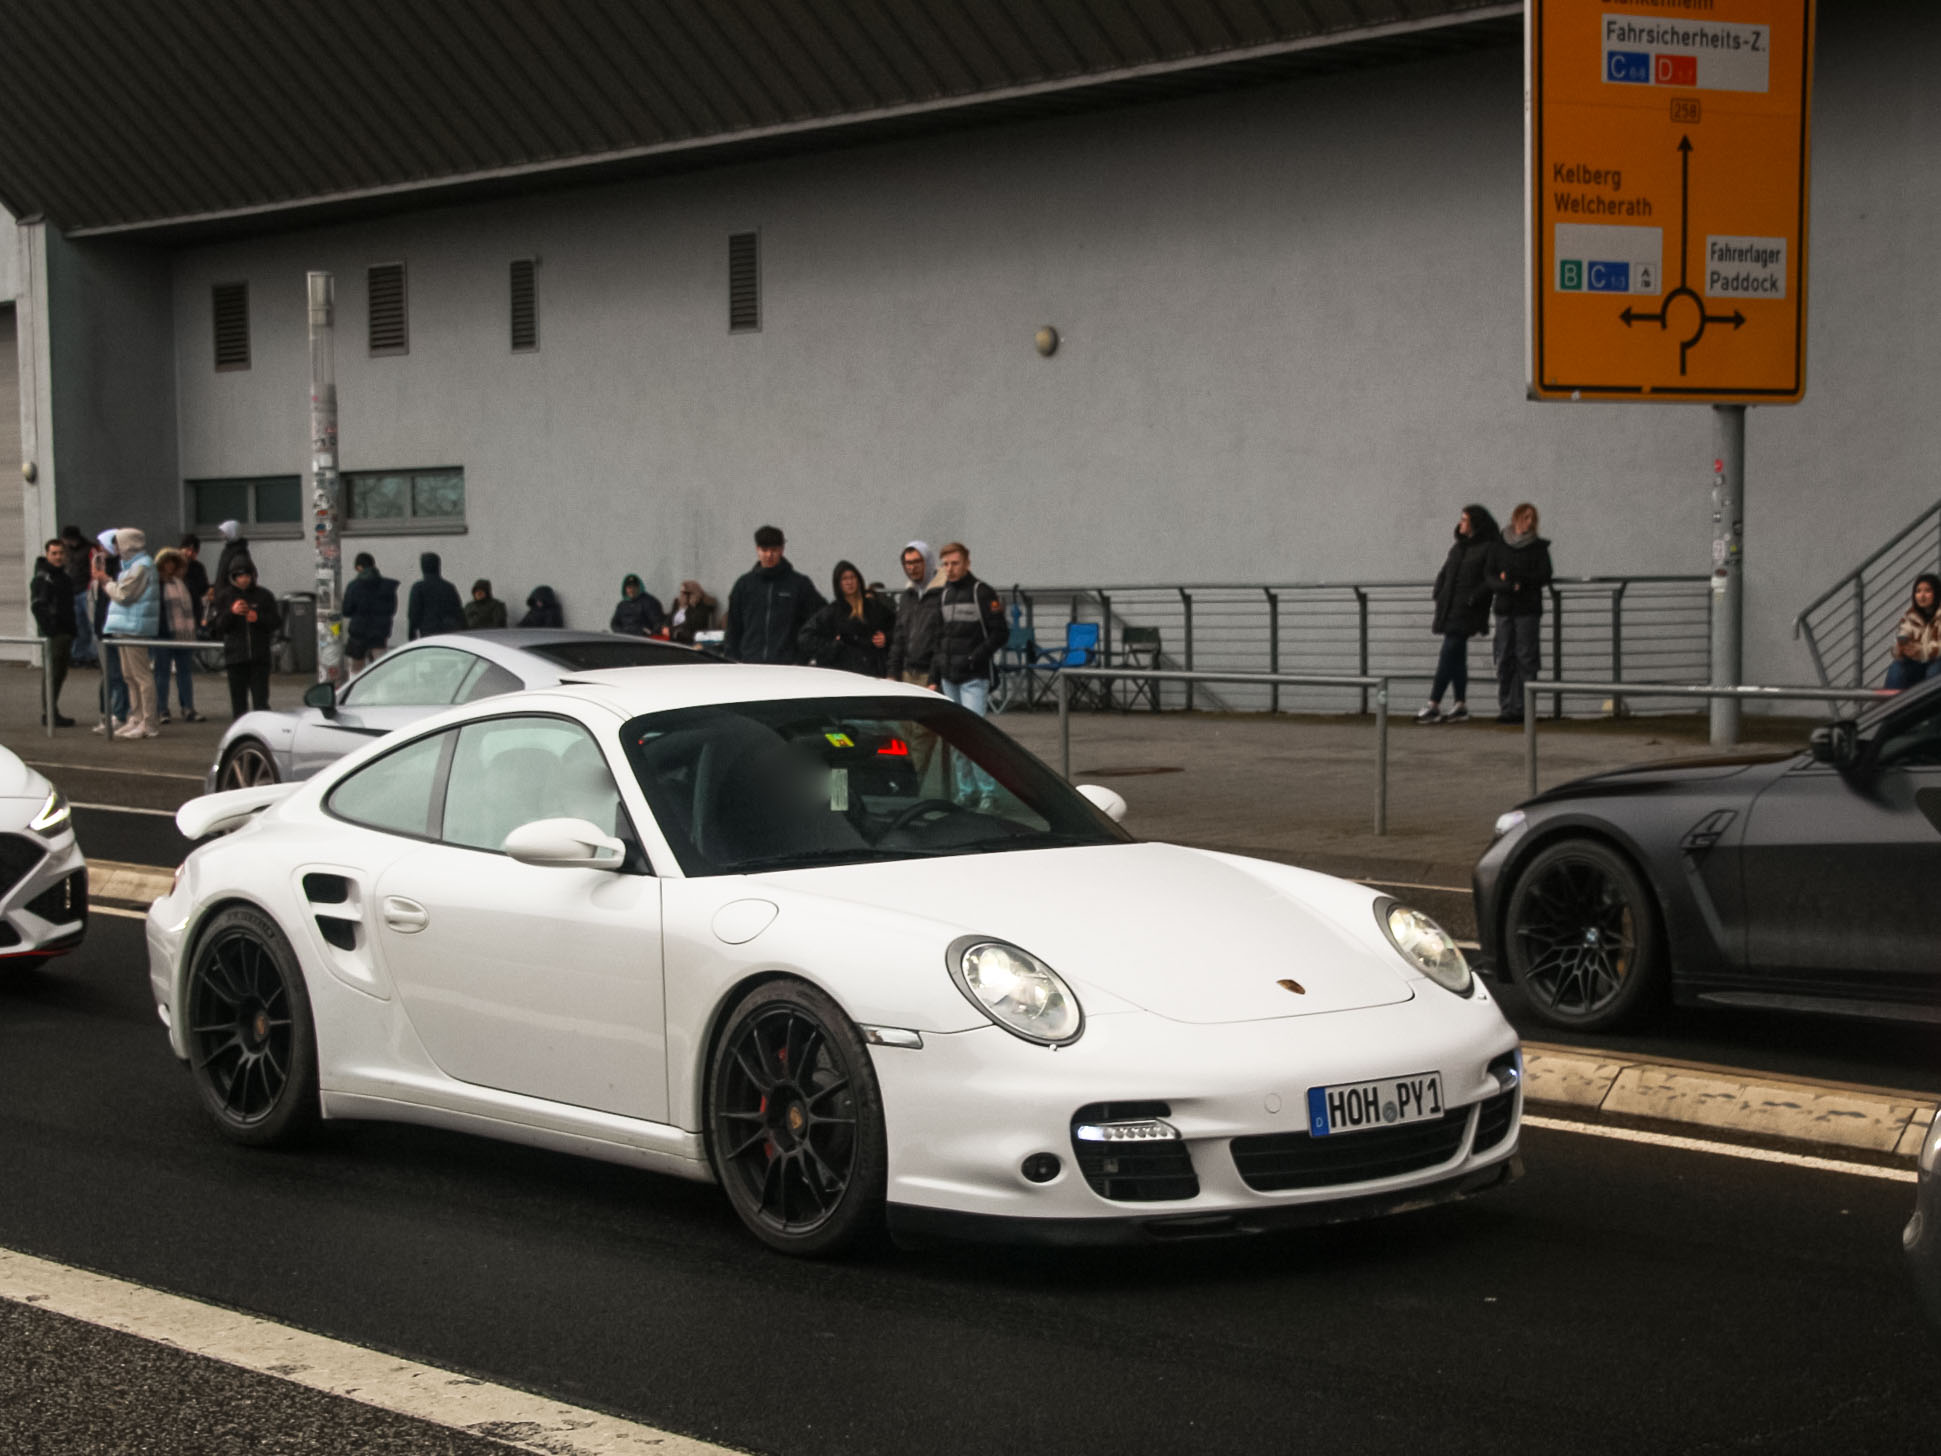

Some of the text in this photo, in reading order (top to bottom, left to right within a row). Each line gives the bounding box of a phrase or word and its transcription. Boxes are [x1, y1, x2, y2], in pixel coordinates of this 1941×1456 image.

[1610, 55, 1626, 79] C
[1658, 58, 1673, 81] D
[1553, 163, 1621, 191] Kelberg
[1554, 192, 1653, 217] Welcherath
[1710, 242, 1781, 268] Fahrerlager
[1564, 263, 1578, 286] B
[1591, 265, 1606, 288] C
[1710, 270, 1779, 293] Paddock
[1328, 1086, 1380, 1128] HOH
